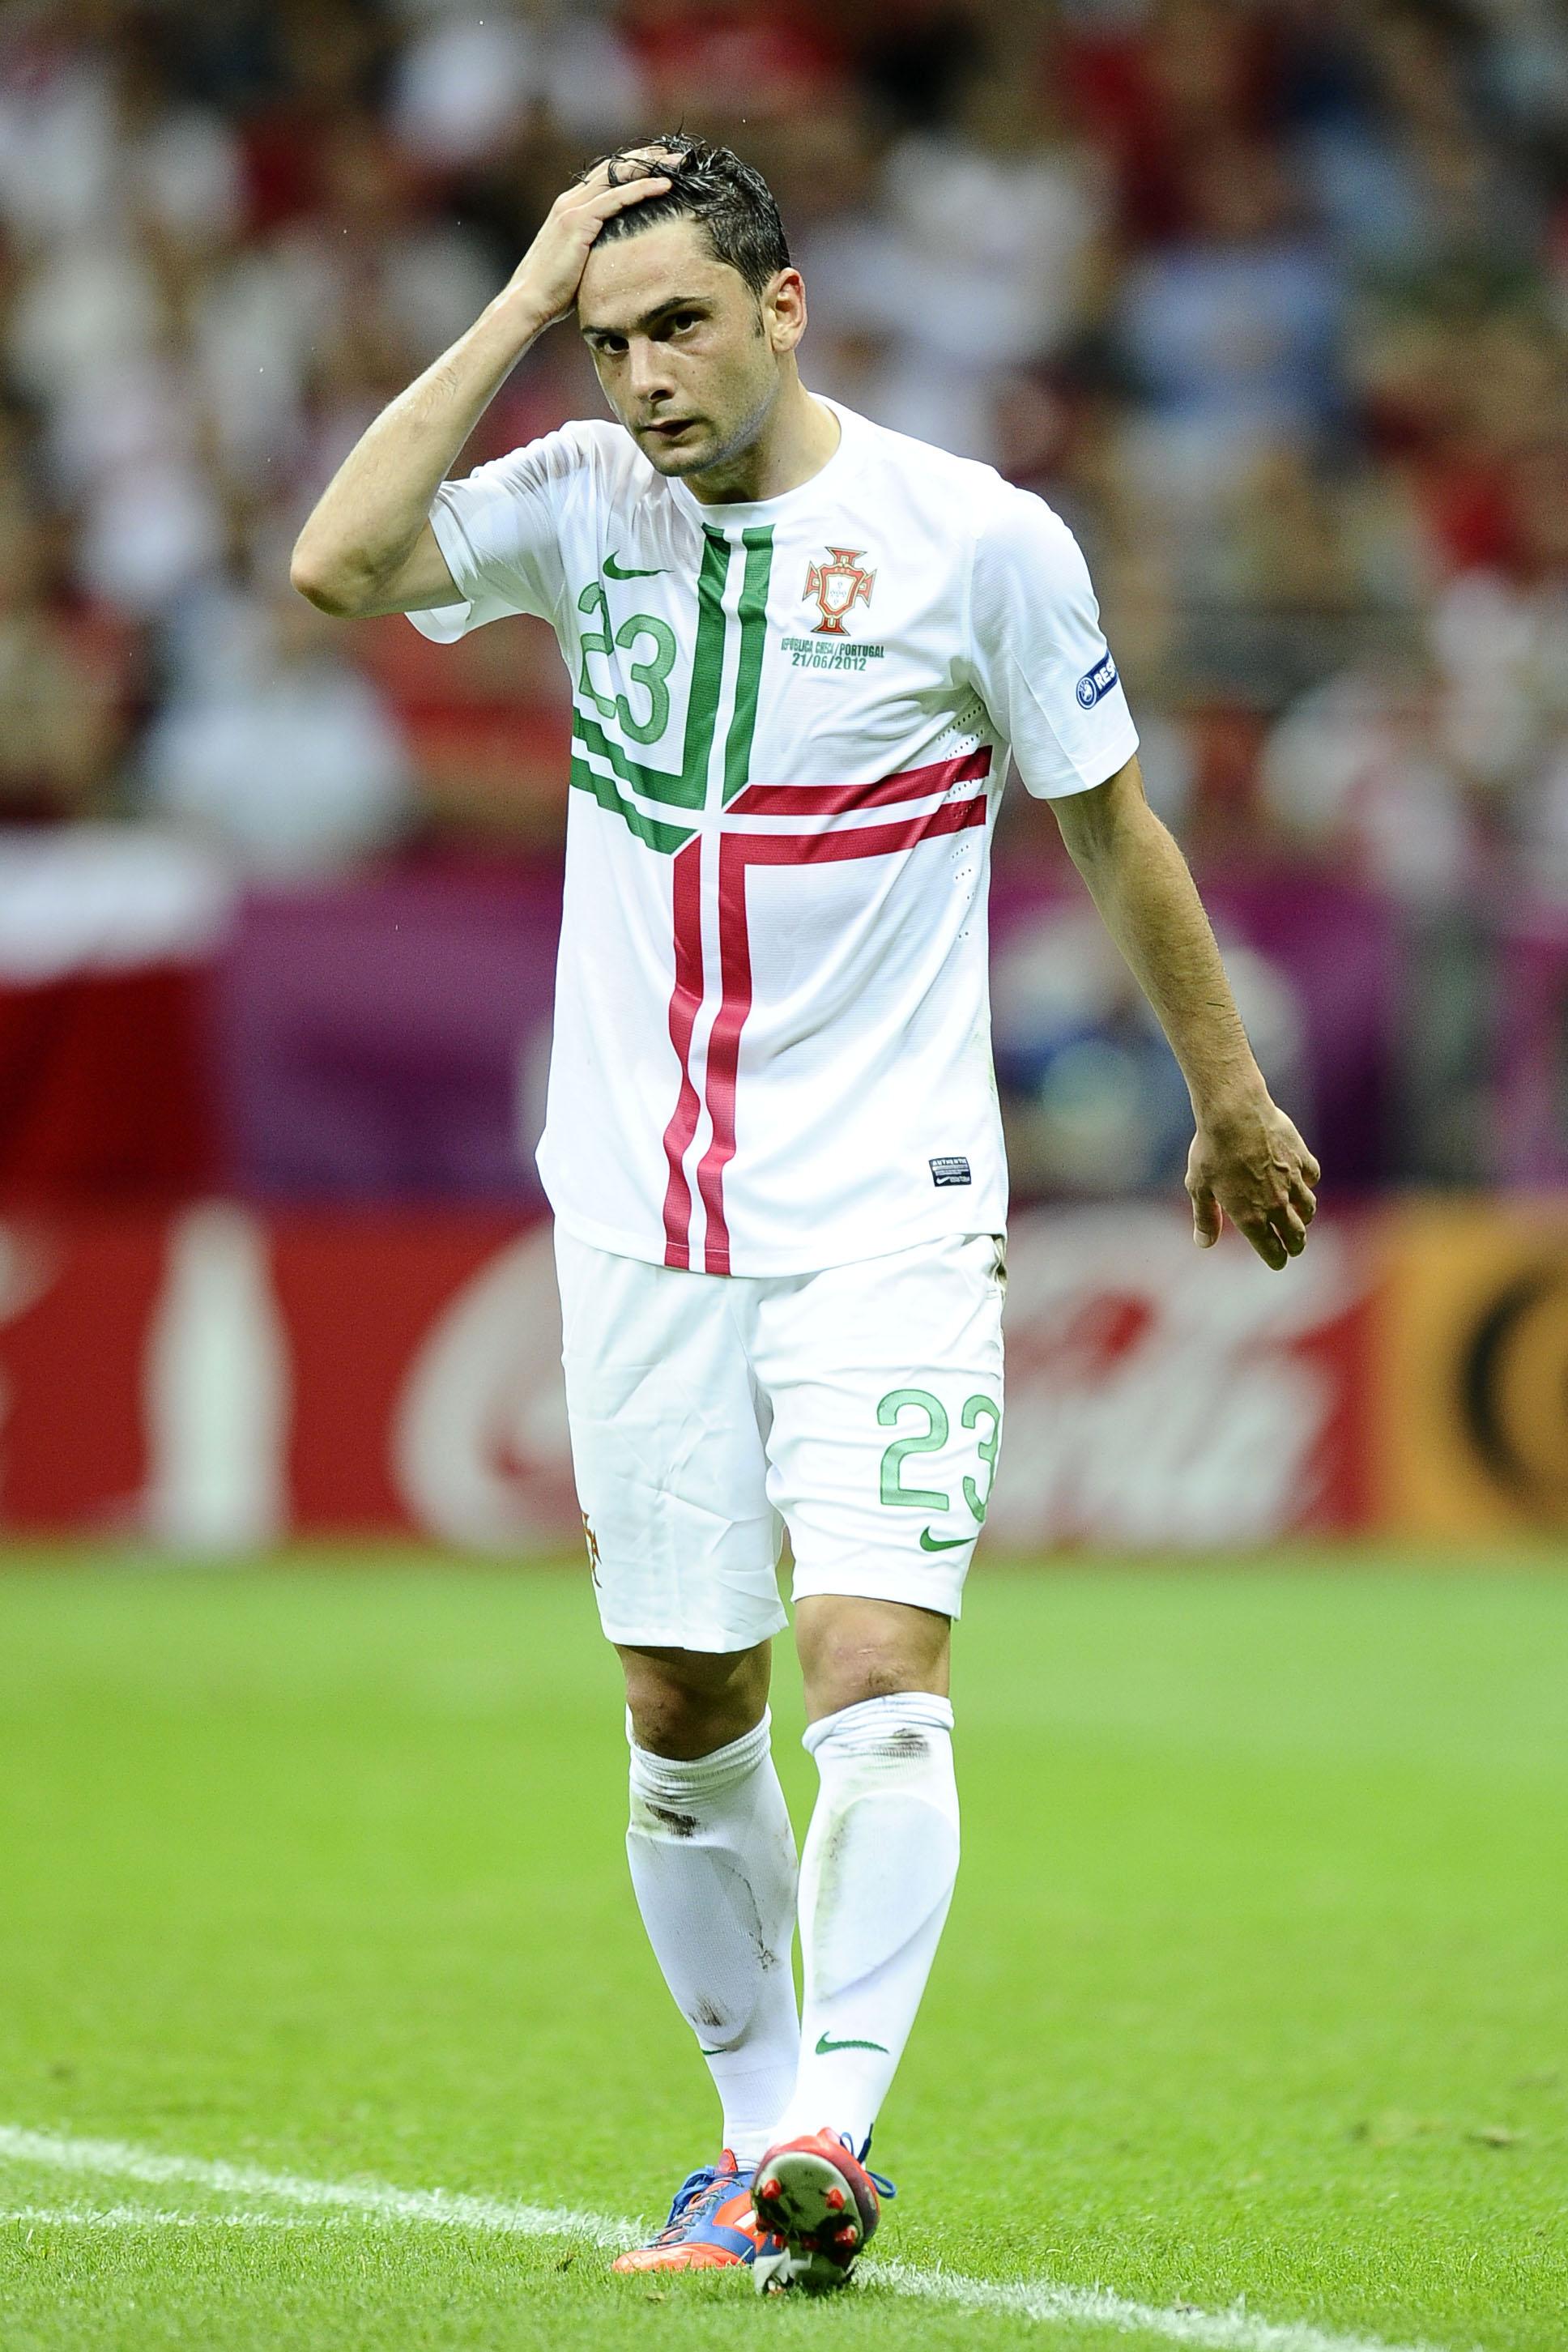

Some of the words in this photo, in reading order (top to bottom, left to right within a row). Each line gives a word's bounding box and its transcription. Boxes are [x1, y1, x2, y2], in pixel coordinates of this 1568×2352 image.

[577, 581, 676, 745] 23
[791, 653, 867, 671] 21/06/2012
[877, 1389, 1000, 1523] 23
